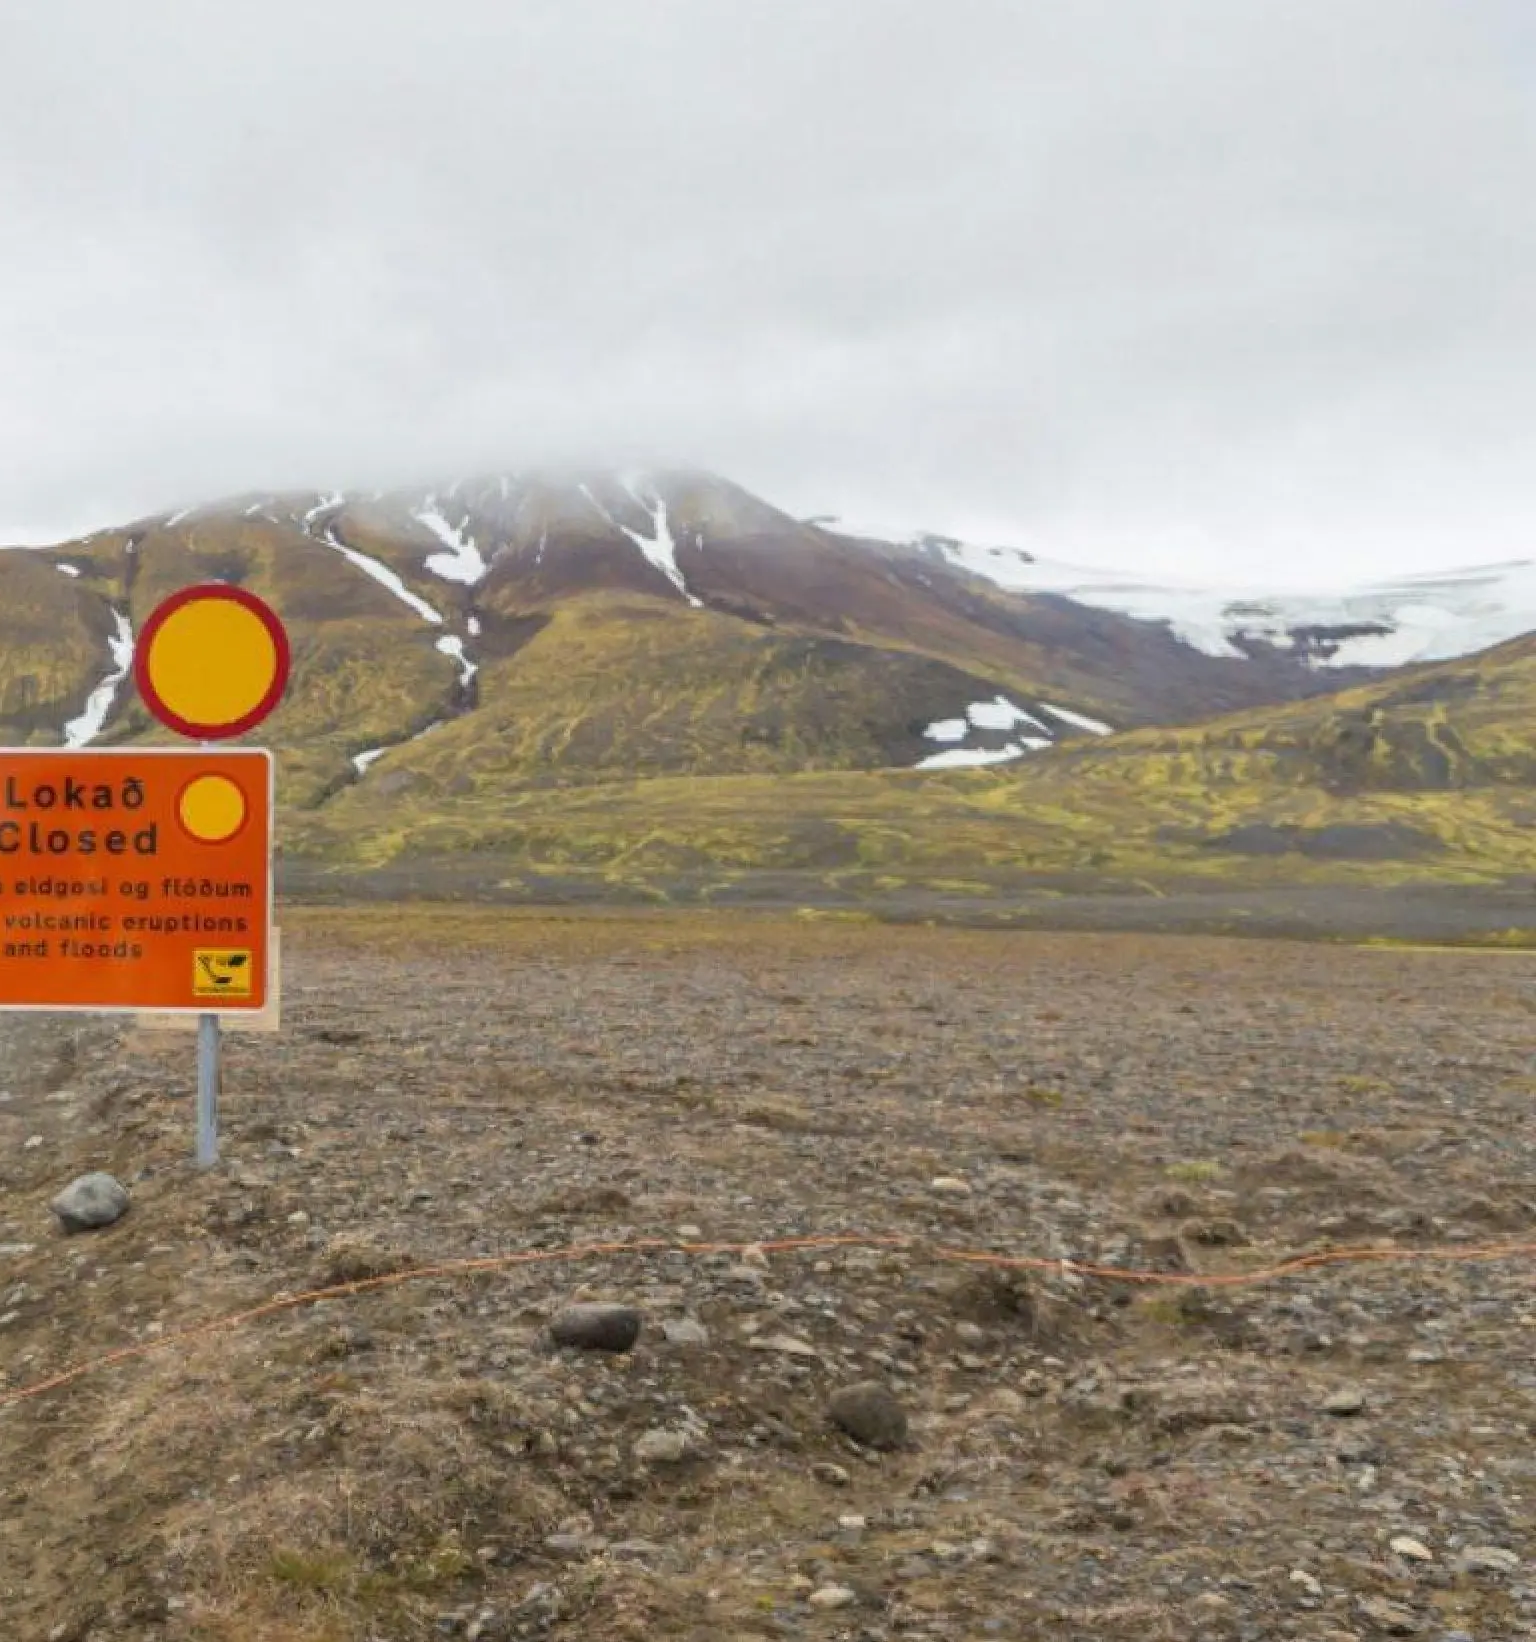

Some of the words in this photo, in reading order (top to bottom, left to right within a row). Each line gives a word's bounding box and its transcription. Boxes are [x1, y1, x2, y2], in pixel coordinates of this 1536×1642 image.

[5, 776, 145, 810] Lokað
[15, 876, 108, 898] eldgosi
[119, 881, 150, 900] og
[163, 877, 252, 897] flóðum
[5, 911, 112, 930] volcanic
[122, 914, 249, 935] eruptions
[4, 940, 48, 957] and
[61, 939, 143, 958] floods
